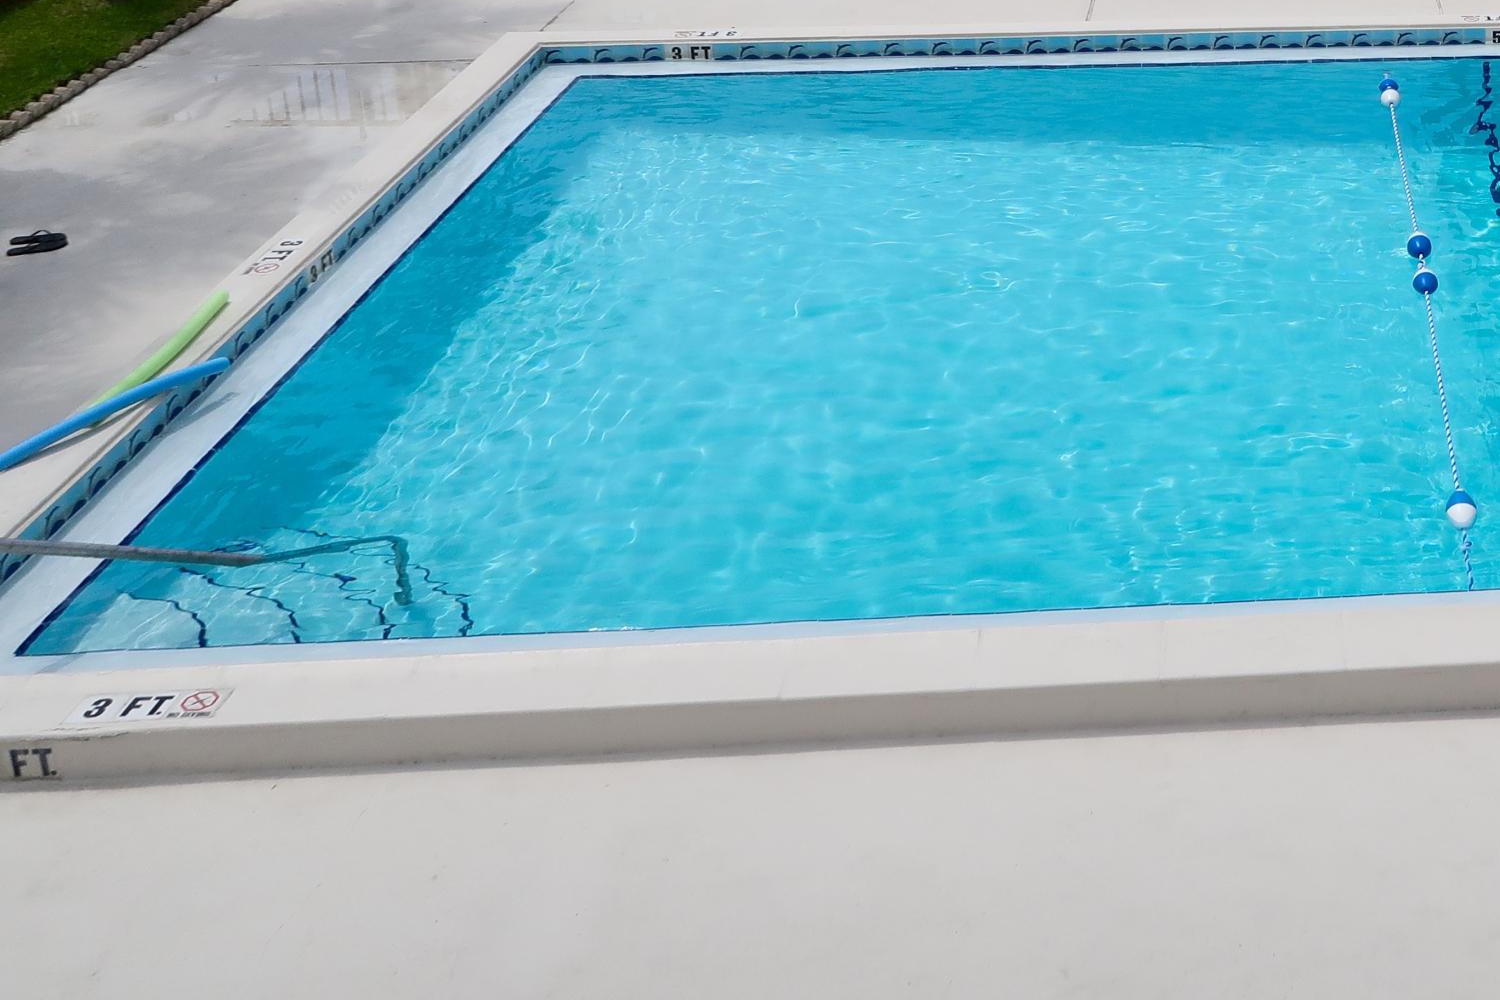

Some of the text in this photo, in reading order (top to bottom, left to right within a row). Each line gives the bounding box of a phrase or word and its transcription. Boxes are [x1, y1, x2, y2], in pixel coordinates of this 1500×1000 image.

[671, 47, 711, 60] 3 FT
[321, 249, 333, 272] FT
[83, 695, 175, 718] 3 FT.
[9, 748, 57, 777] FT.
